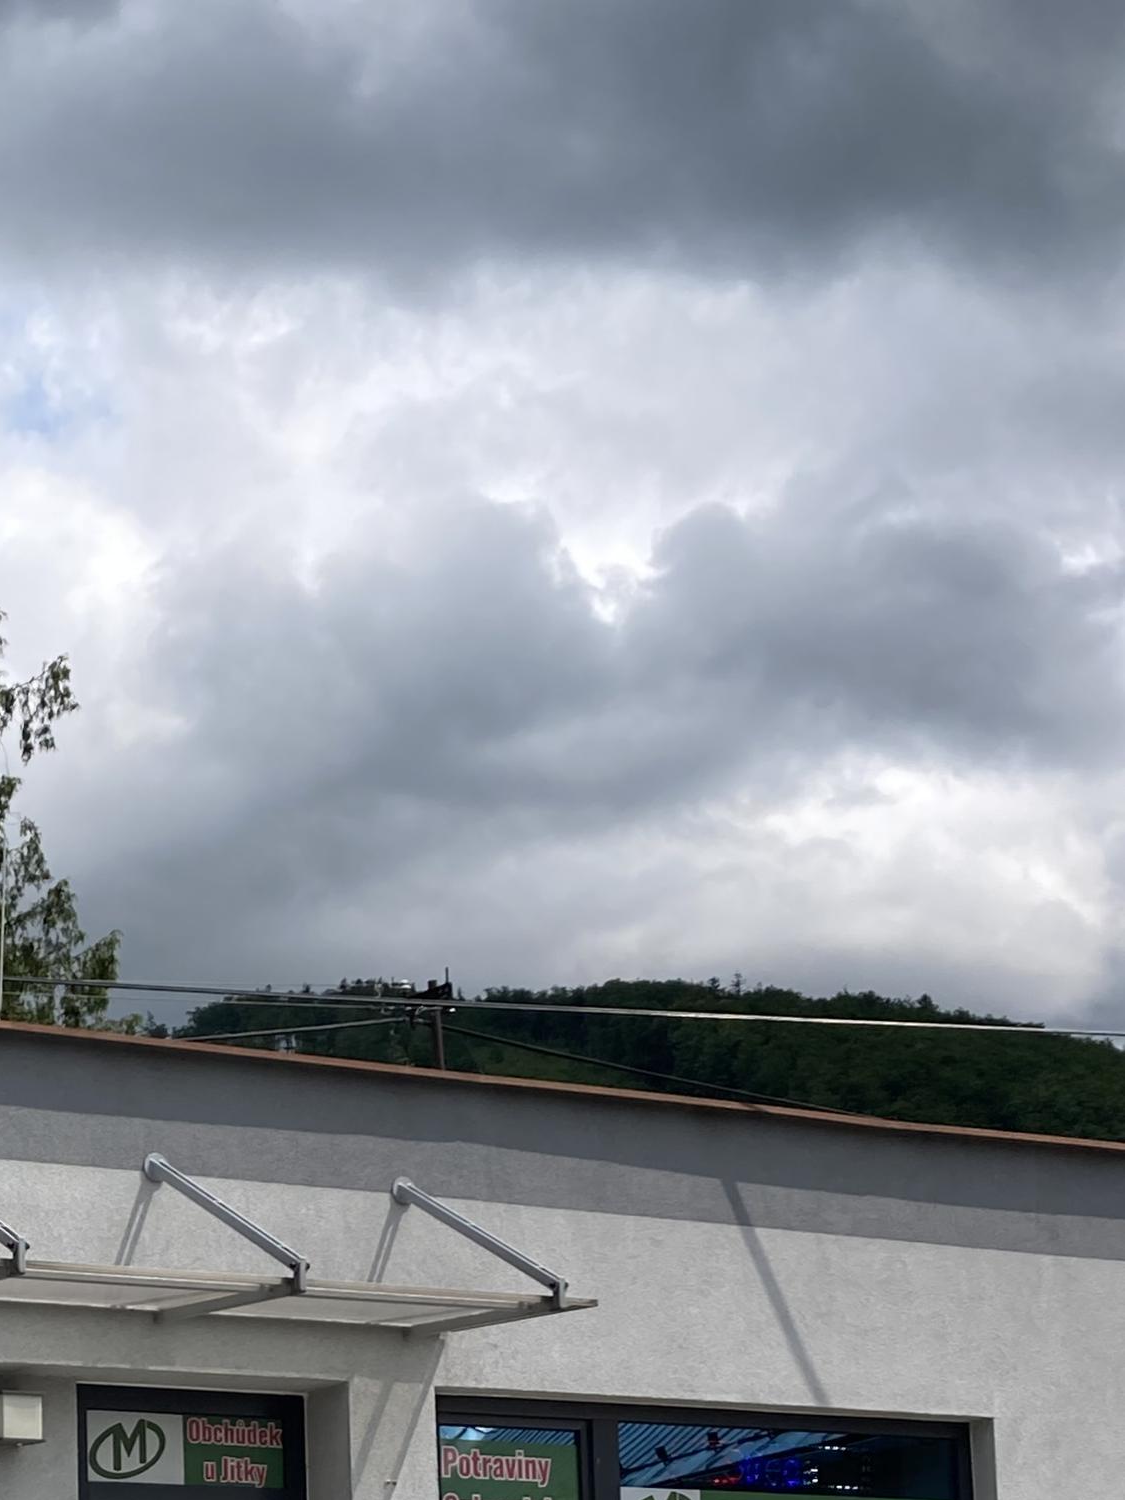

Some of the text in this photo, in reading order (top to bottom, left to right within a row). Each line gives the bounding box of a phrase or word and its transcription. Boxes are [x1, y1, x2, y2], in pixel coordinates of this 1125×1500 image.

[187, 1417, 283, 1447] Obchůdek
[203, 1456, 268, 1488] u Jitky
[442, 1446, 551, 1487] Potraviny
